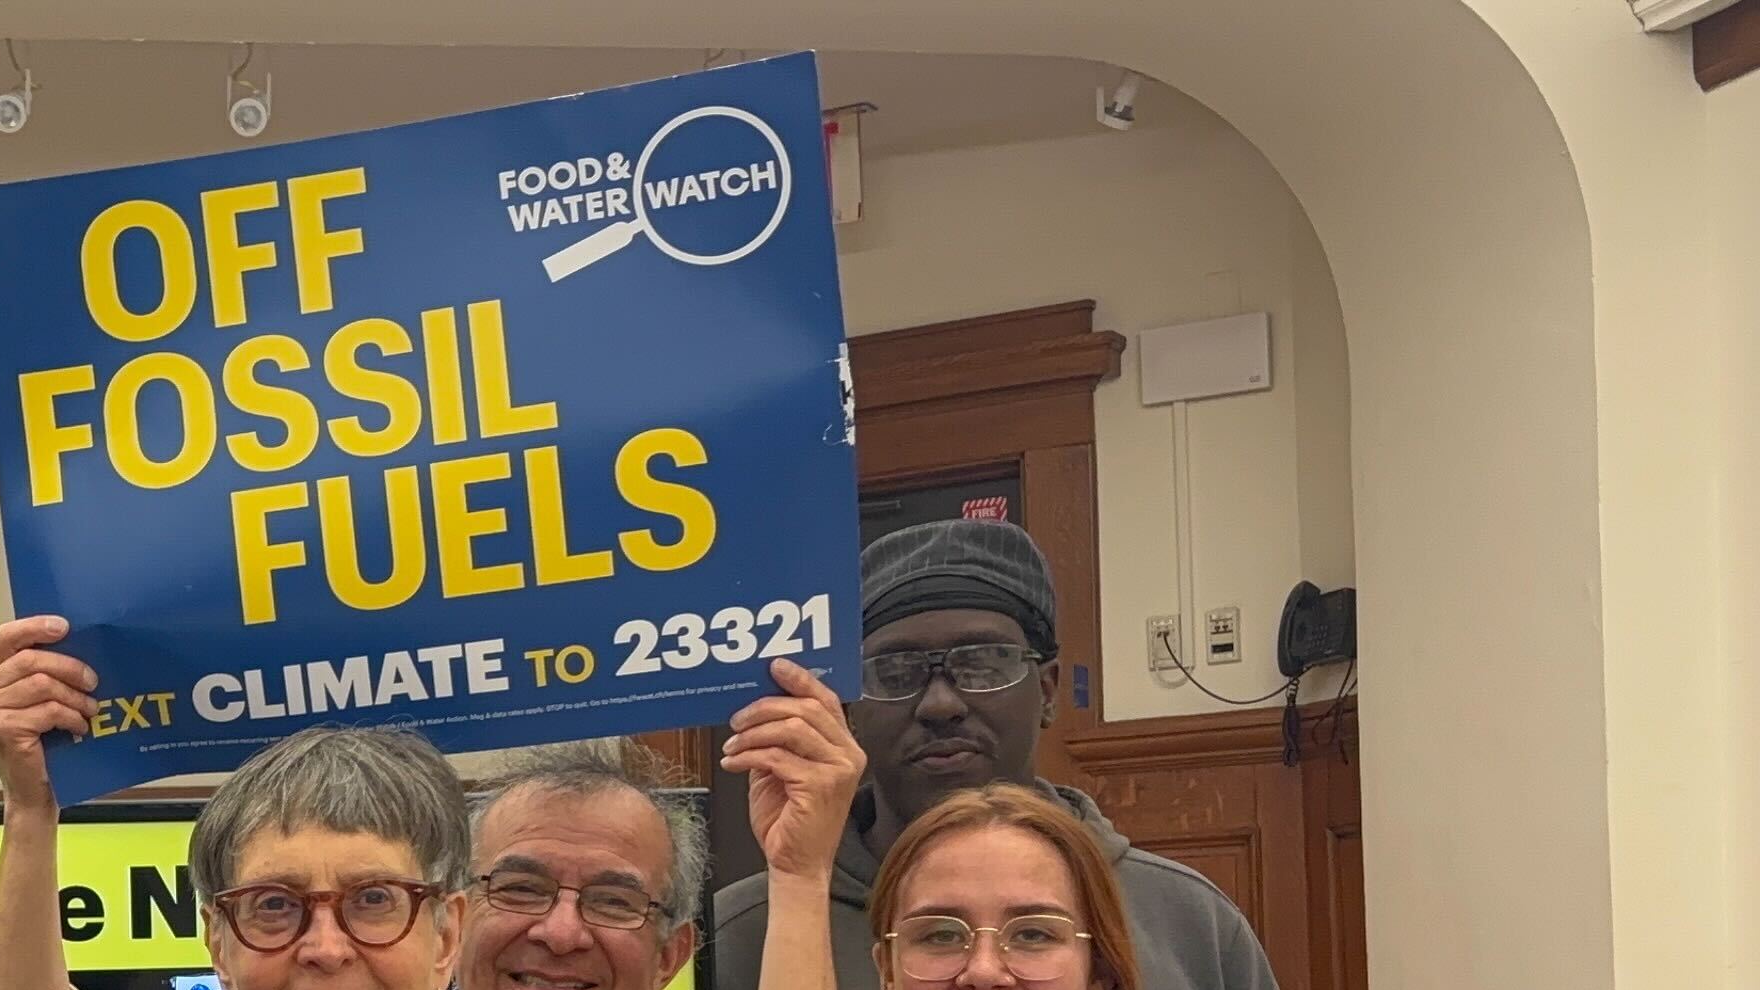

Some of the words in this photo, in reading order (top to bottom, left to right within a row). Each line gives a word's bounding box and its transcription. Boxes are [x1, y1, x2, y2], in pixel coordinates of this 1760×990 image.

[81, 168, 366, 343] OFF
[506, 187, 630, 233] WATER
[646, 158, 778, 211] WATCH
[18, 299, 558, 508] FOSSIL
[231, 427, 718, 626] FUELS
[73, 692, 176, 744] EXT
[193, 638, 509, 721] CLIMATE
[527, 645, 594, 685] TO
[614, 594, 830, 676] 23321
